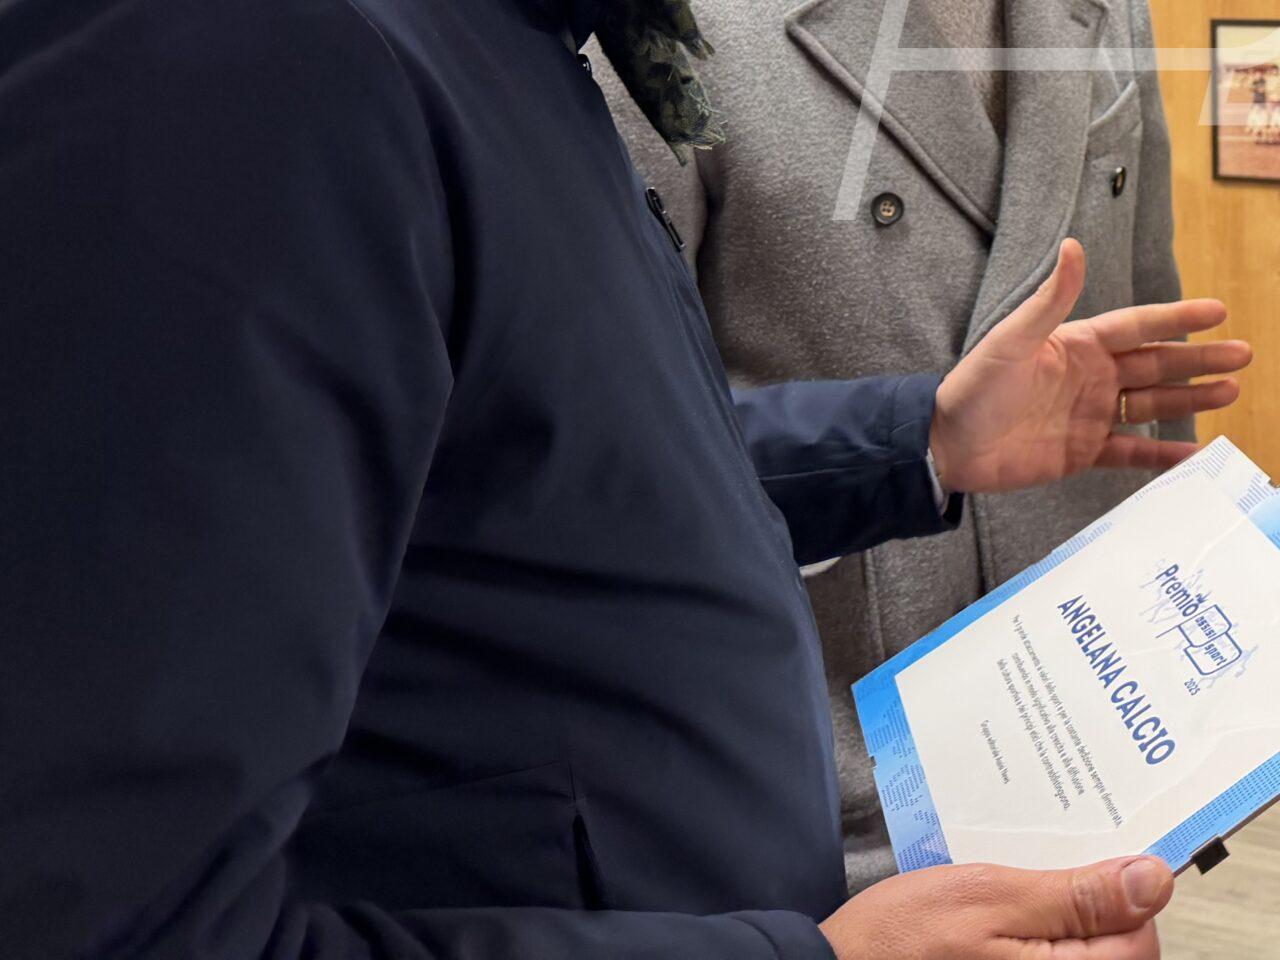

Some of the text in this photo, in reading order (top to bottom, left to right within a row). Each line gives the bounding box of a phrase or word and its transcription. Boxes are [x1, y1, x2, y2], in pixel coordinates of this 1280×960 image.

[1155, 564, 1228, 666] Premio assisi sport
[1057, 595, 1175, 764] ANGELANA CALCIO
[1184, 678, 1200, 696] 2025
[1001, 768, 1010, 784] News
[1048, 733, 1065, 754] crescita
[1067, 767, 1085, 795] diffusione
[1049, 694, 1063, 708] sport
[1066, 724, 1082, 747] costante
[1077, 745, 1095, 772] dedizione
[1088, 771, 1106, 794] sempre
